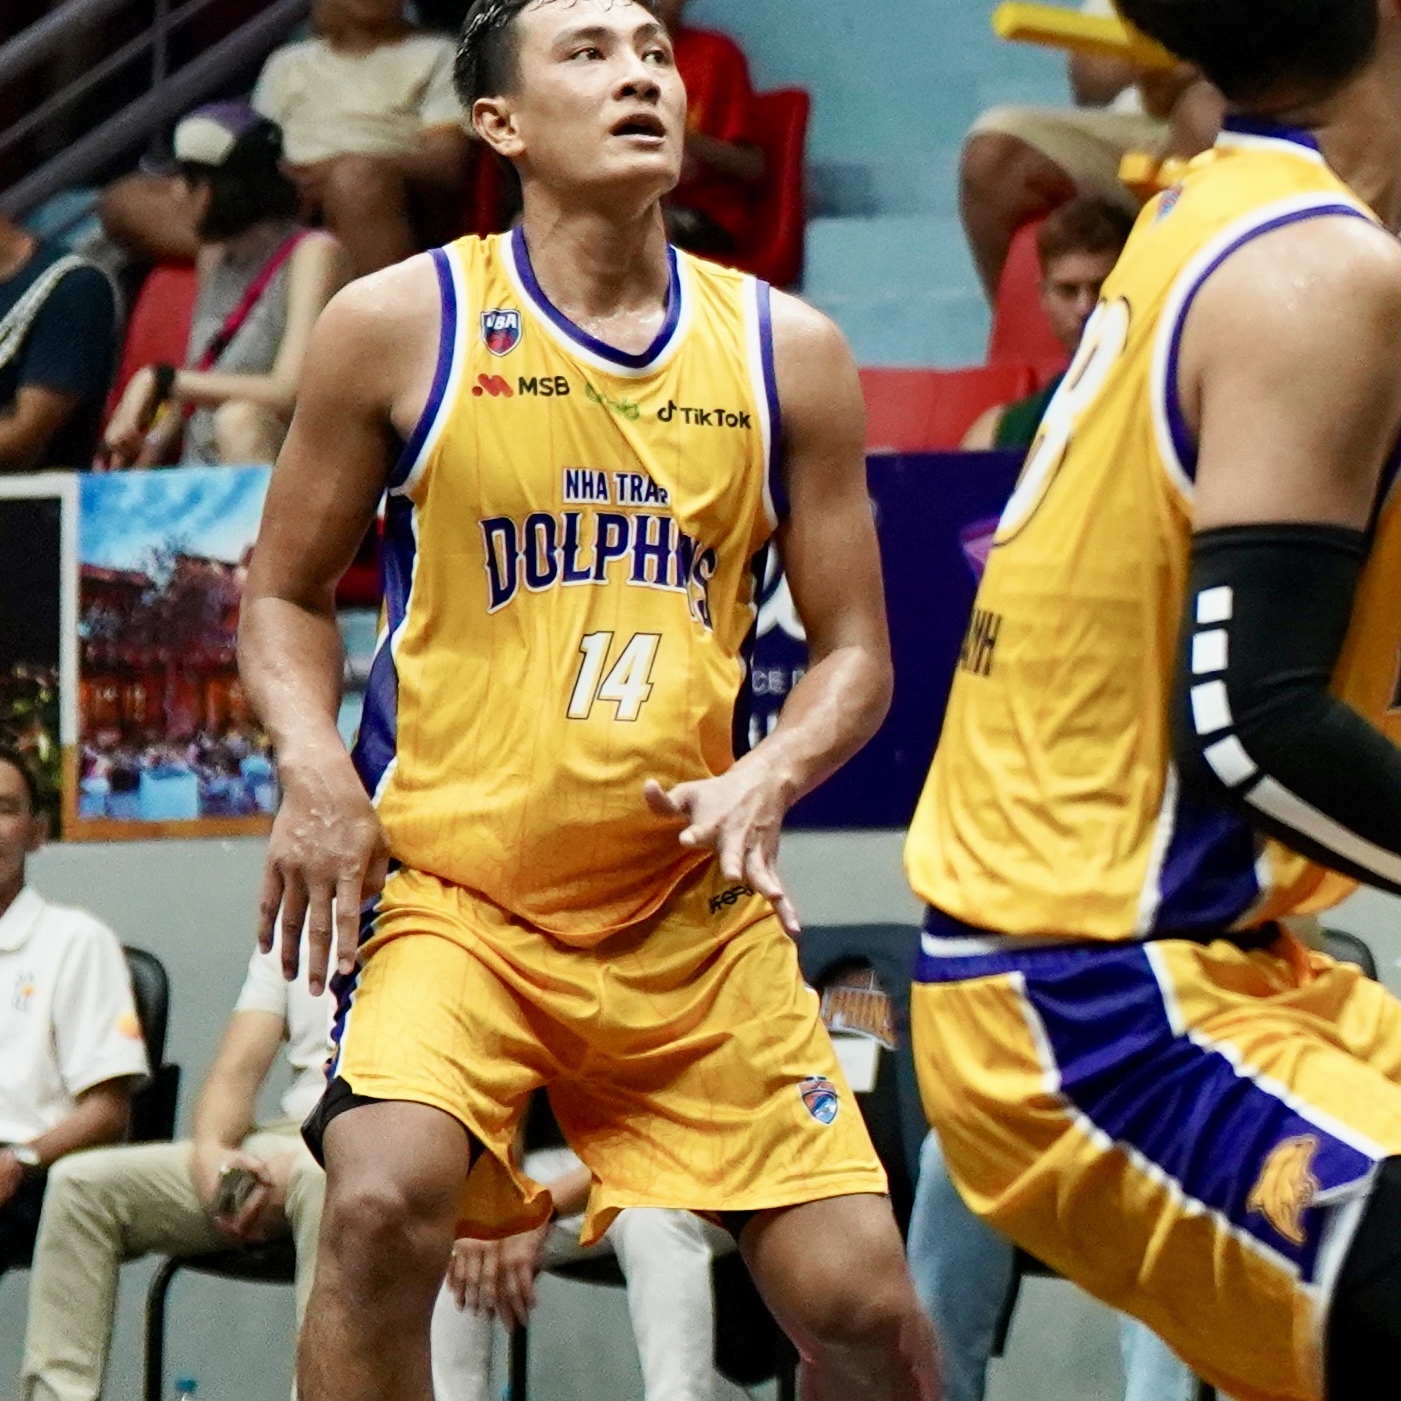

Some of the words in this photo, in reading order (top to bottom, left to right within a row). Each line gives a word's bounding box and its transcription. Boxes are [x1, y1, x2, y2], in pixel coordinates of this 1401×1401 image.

[518, 376, 570, 397] MSB
[680, 406, 752, 430] TikTok
[565, 468, 609, 502] NHA
[566, 631, 662, 721] 14
